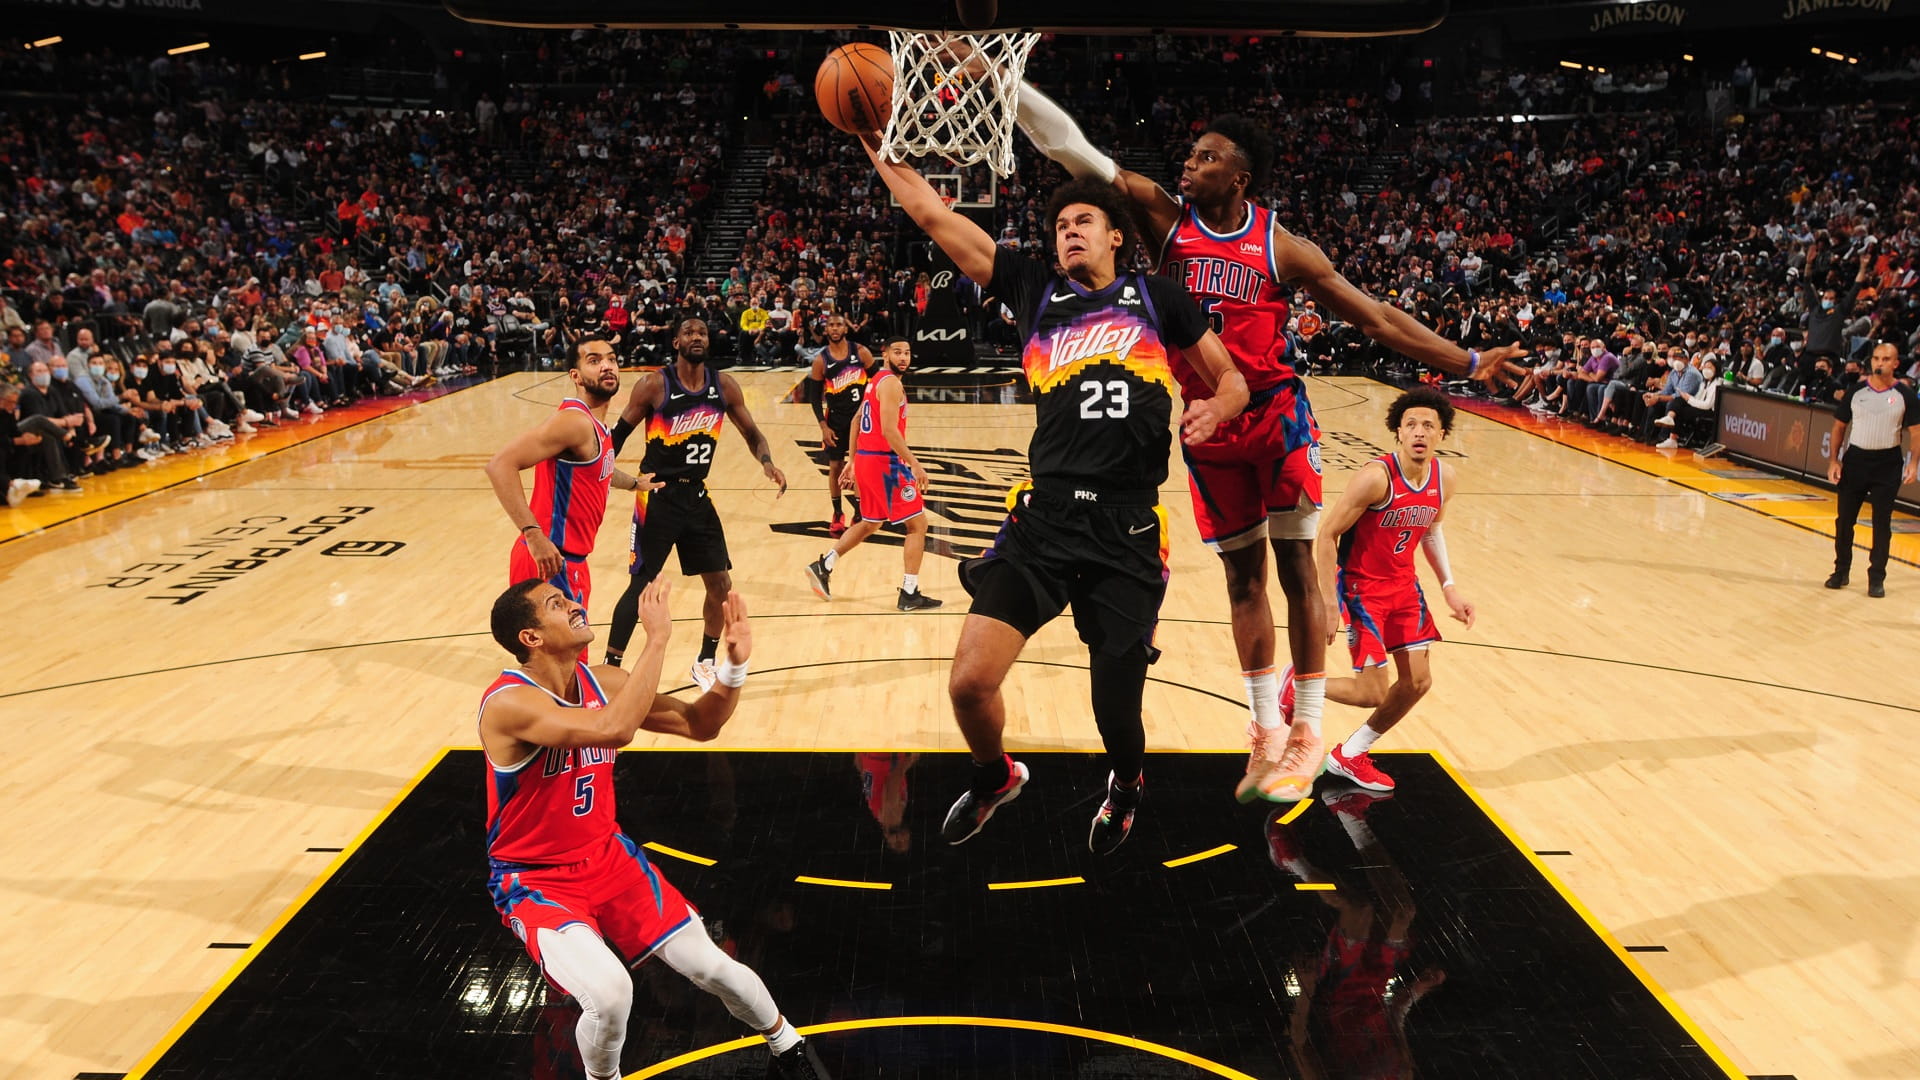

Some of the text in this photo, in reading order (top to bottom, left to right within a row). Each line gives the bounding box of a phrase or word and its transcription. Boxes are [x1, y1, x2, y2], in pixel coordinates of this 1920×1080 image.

[1590, 3, 1686, 32] JAMESON
[1240, 243, 1262, 253] UWM
[1168, 257, 1267, 305] DETROIT
[1118, 298, 1141, 306] PayPal
[1049, 322, 1142, 372] Valley
[850, 388, 860, 402] 3
[1080, 380, 1130, 419] 23
[670, 411, 719, 435] Valley
[1725, 414, 1767, 440] verizon
[686, 443, 711, 464] 22
[1074, 490, 1098, 502] PHX
[1379, 505, 1438, 528] DETROIT
[85, 515, 288, 589] CENTER
[1393, 530, 1413, 555] 2
[144, 506, 375, 605] FOOTPRINT
[573, 773, 595, 817] 5
